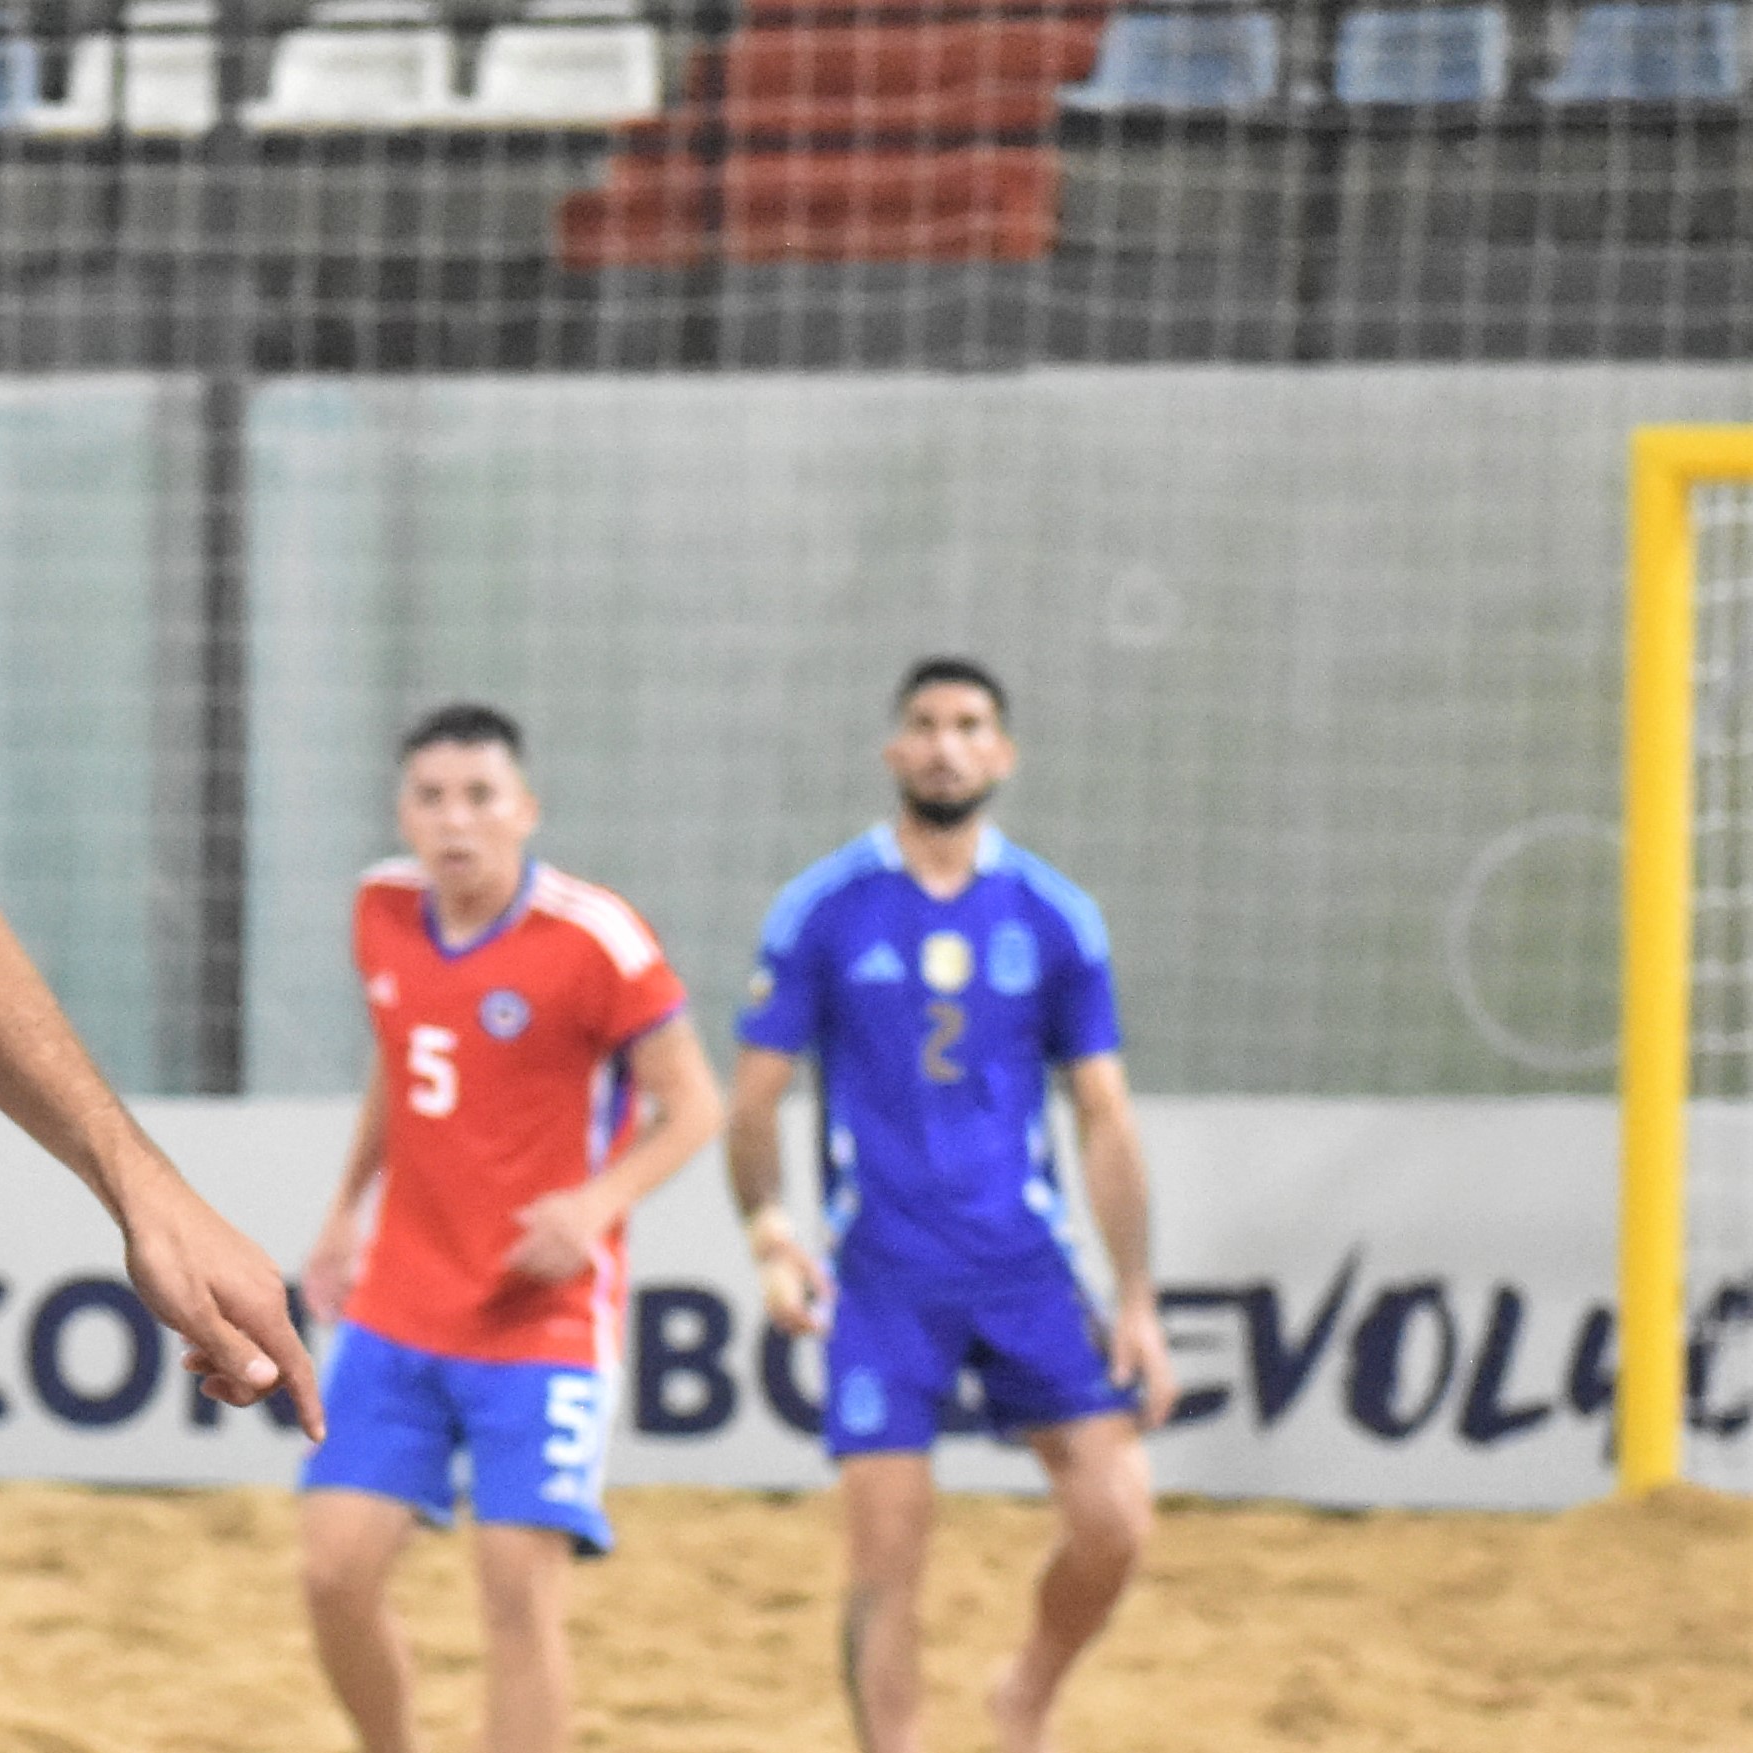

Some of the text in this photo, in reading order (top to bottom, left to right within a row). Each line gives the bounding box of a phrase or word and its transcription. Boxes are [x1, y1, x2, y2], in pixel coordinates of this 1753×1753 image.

[408, 1022, 458, 1119] 5
[921, 1002, 968, 1085] 2
[544, 1372, 600, 1467] 5
